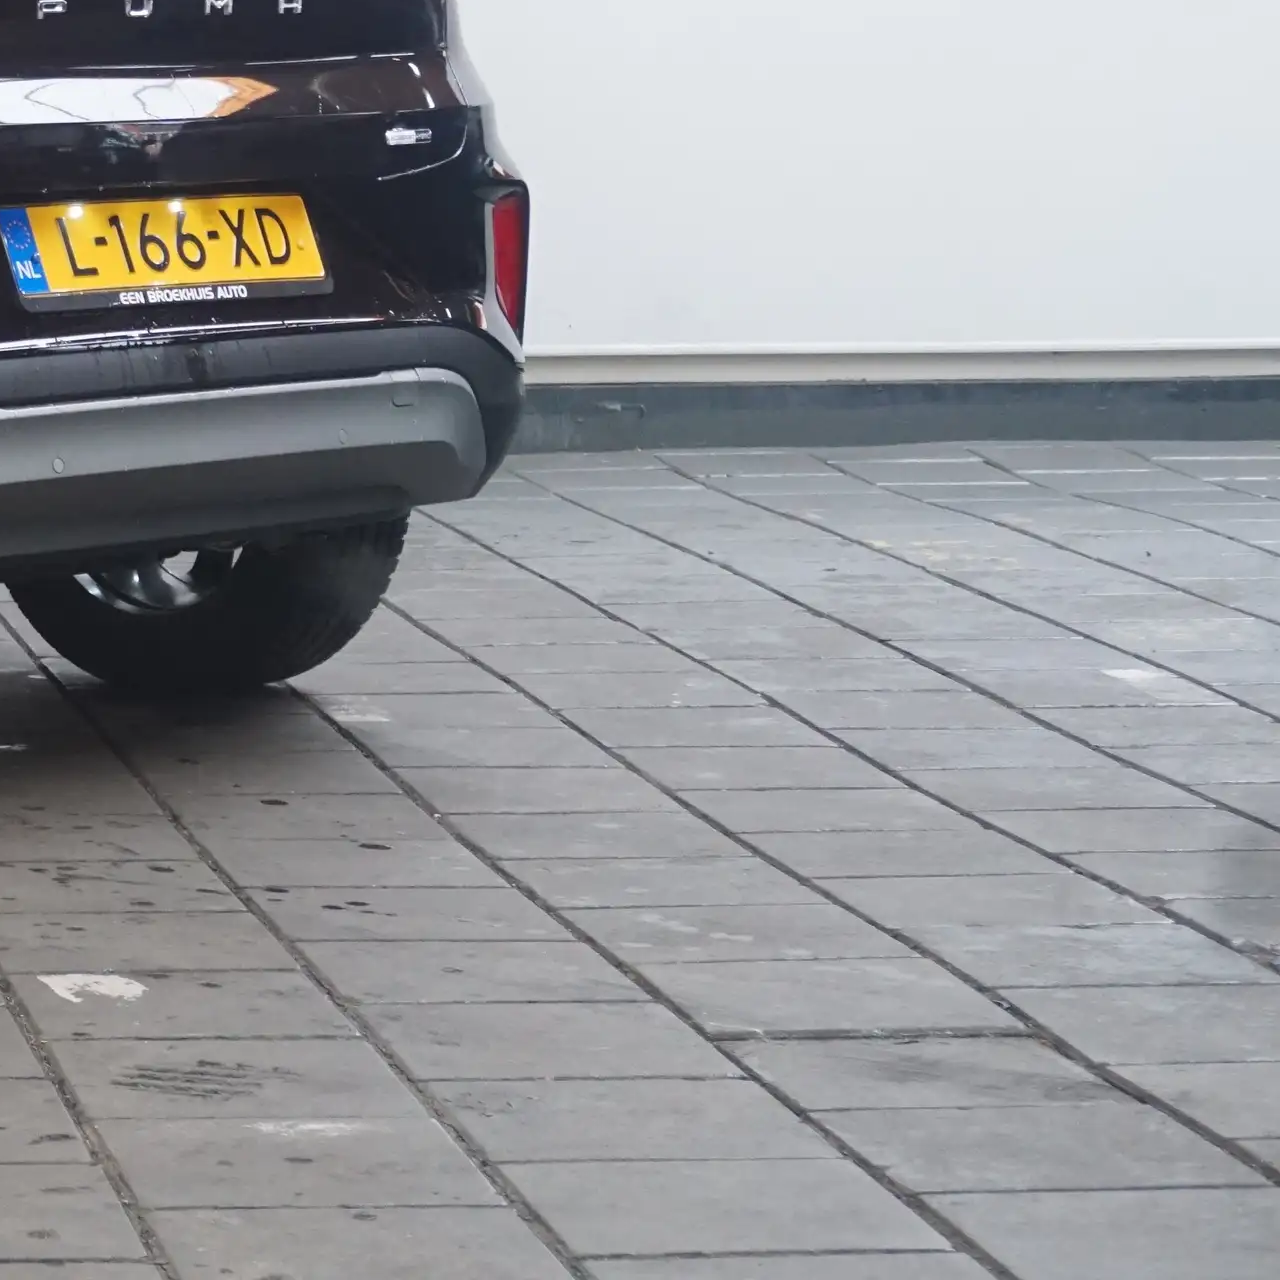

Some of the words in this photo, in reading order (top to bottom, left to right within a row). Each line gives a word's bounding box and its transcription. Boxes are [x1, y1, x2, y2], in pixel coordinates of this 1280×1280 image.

[56, 208, 292, 277] L-166-XD
[16, 260, 42, 279] NL
[120, 292, 146, 305] EEN
[146, 287, 215, 303] BROEKHUIS
[217, 285, 248, 298] AUTO
